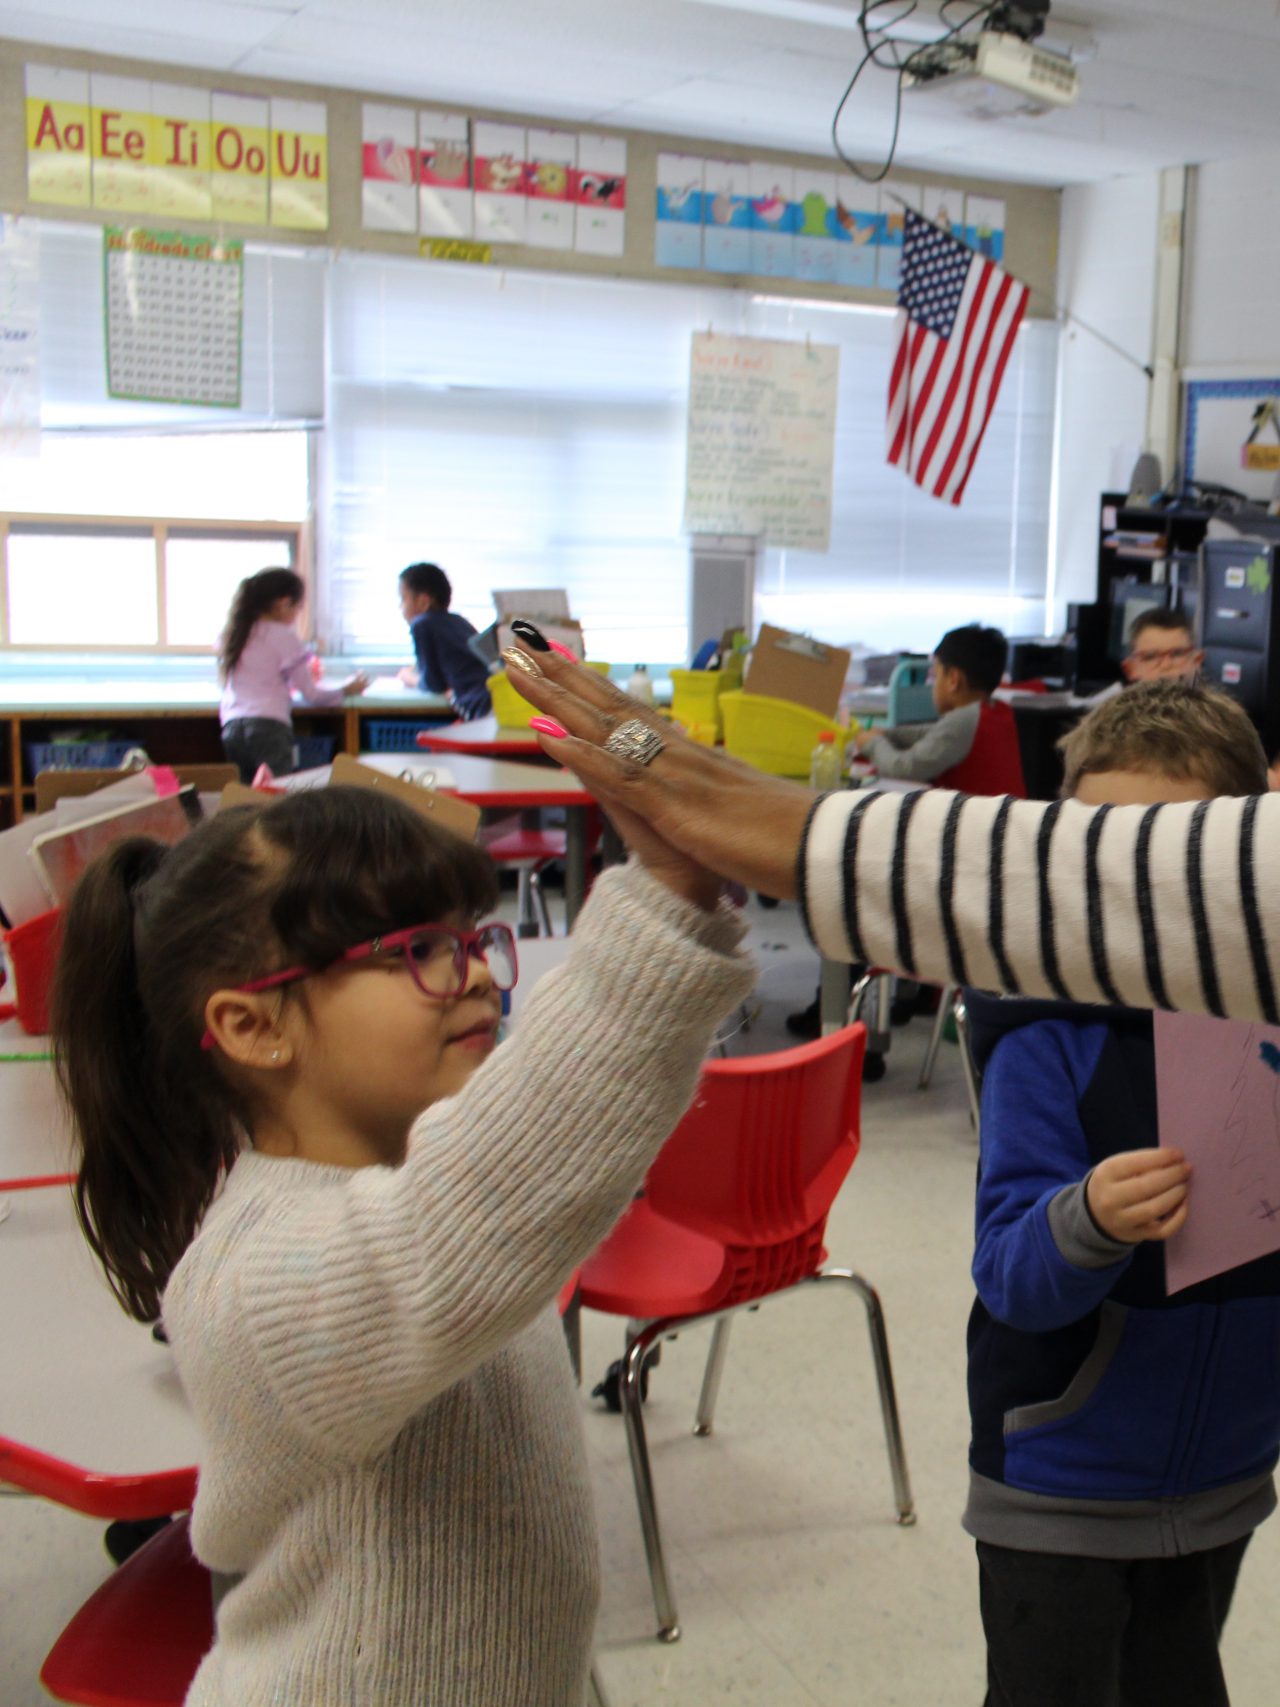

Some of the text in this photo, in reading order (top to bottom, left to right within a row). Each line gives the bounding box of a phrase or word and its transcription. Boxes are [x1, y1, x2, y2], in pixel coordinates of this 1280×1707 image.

[34, 103, 321, 179] Aa Ee Ii Oo Uu
